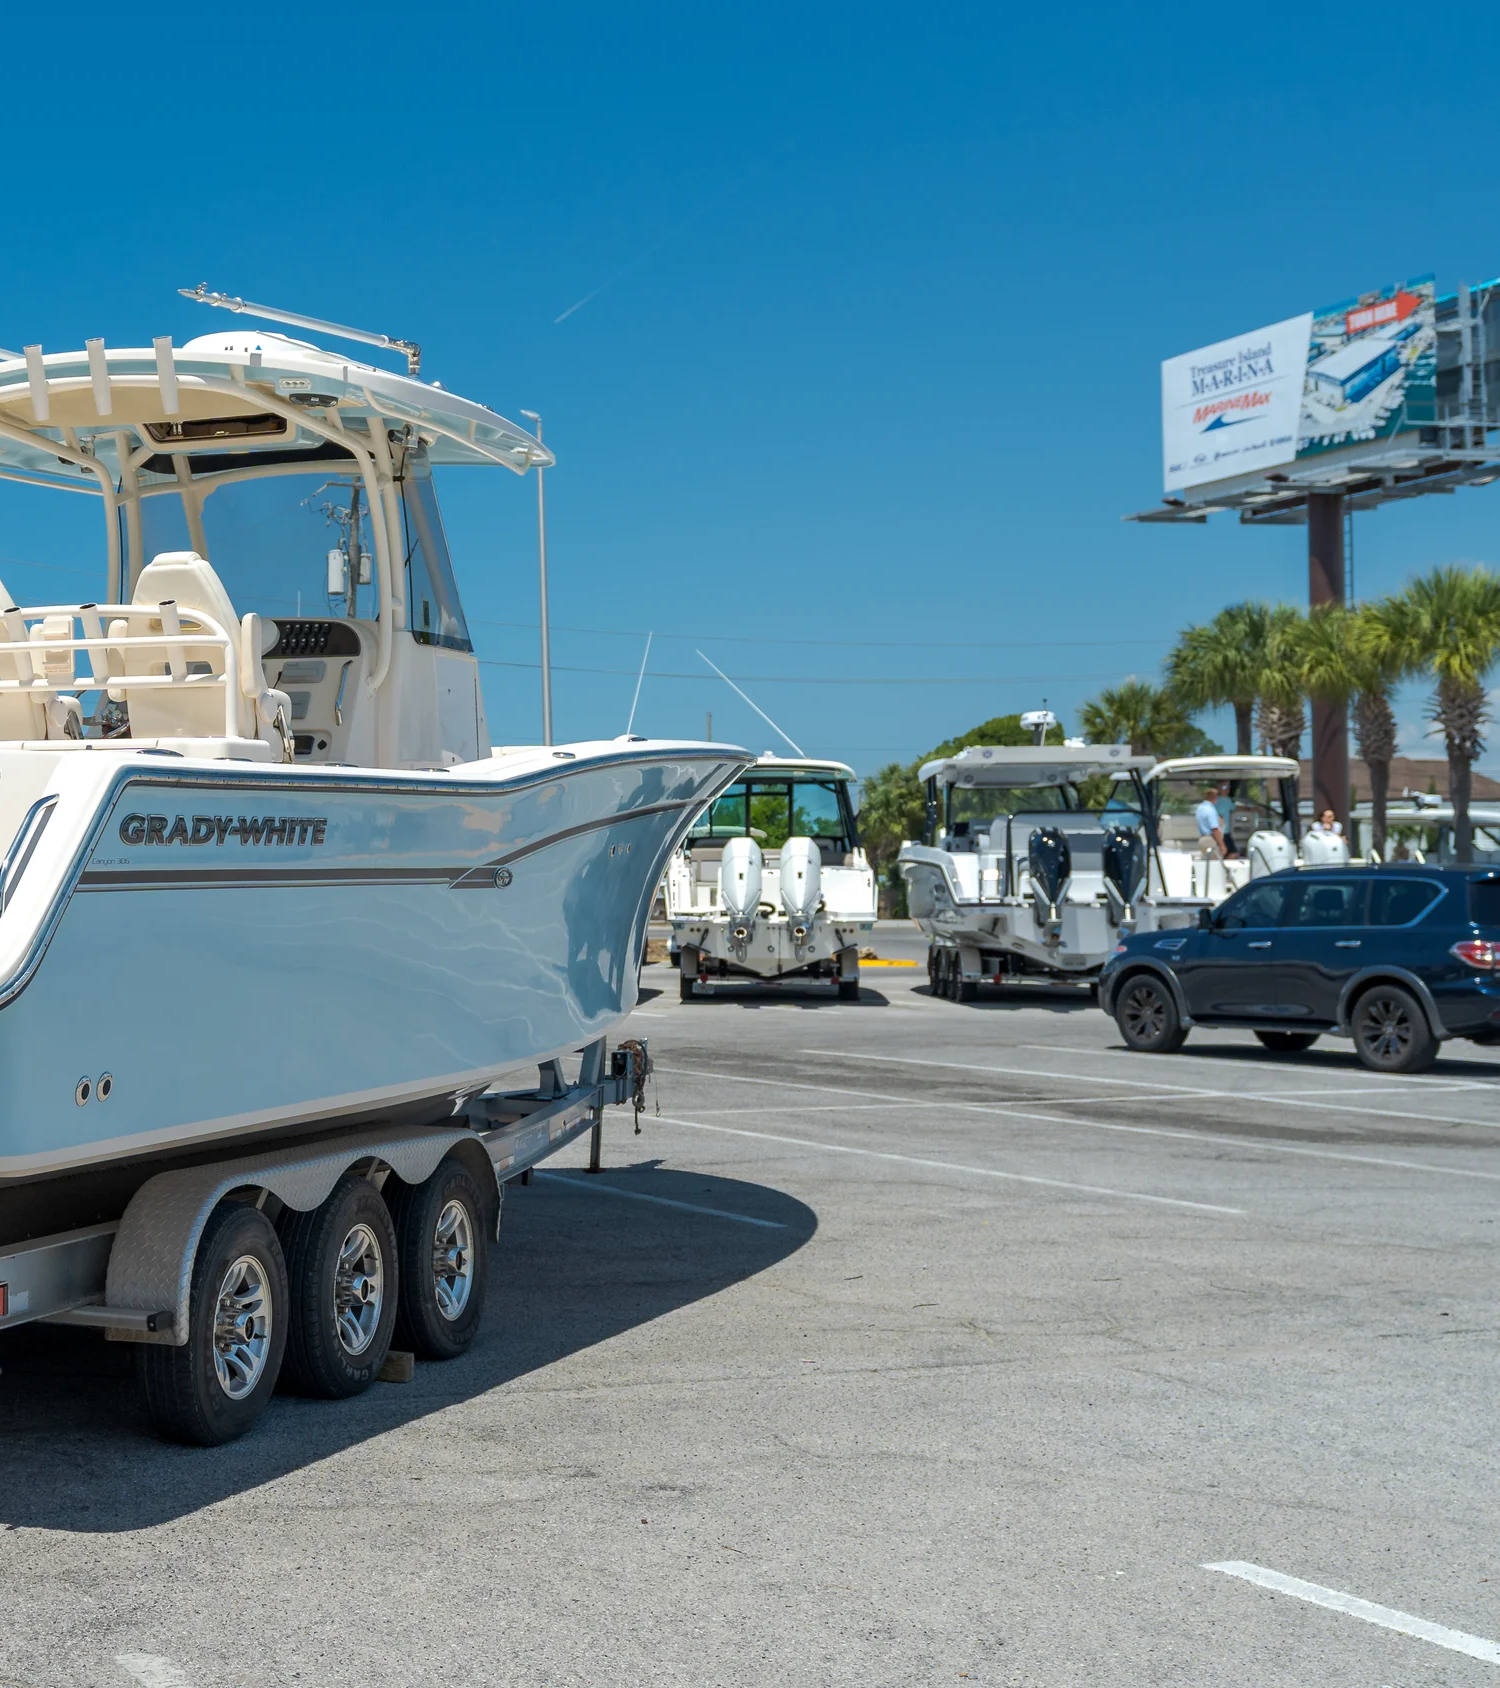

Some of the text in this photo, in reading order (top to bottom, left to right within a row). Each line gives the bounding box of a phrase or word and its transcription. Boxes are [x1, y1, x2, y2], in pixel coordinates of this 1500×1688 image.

[1189, 340, 1272, 379] Treasure Island
[119, 812, 328, 847] GRADY-WHITE
[92, 857, 130, 866] Canyon 306
